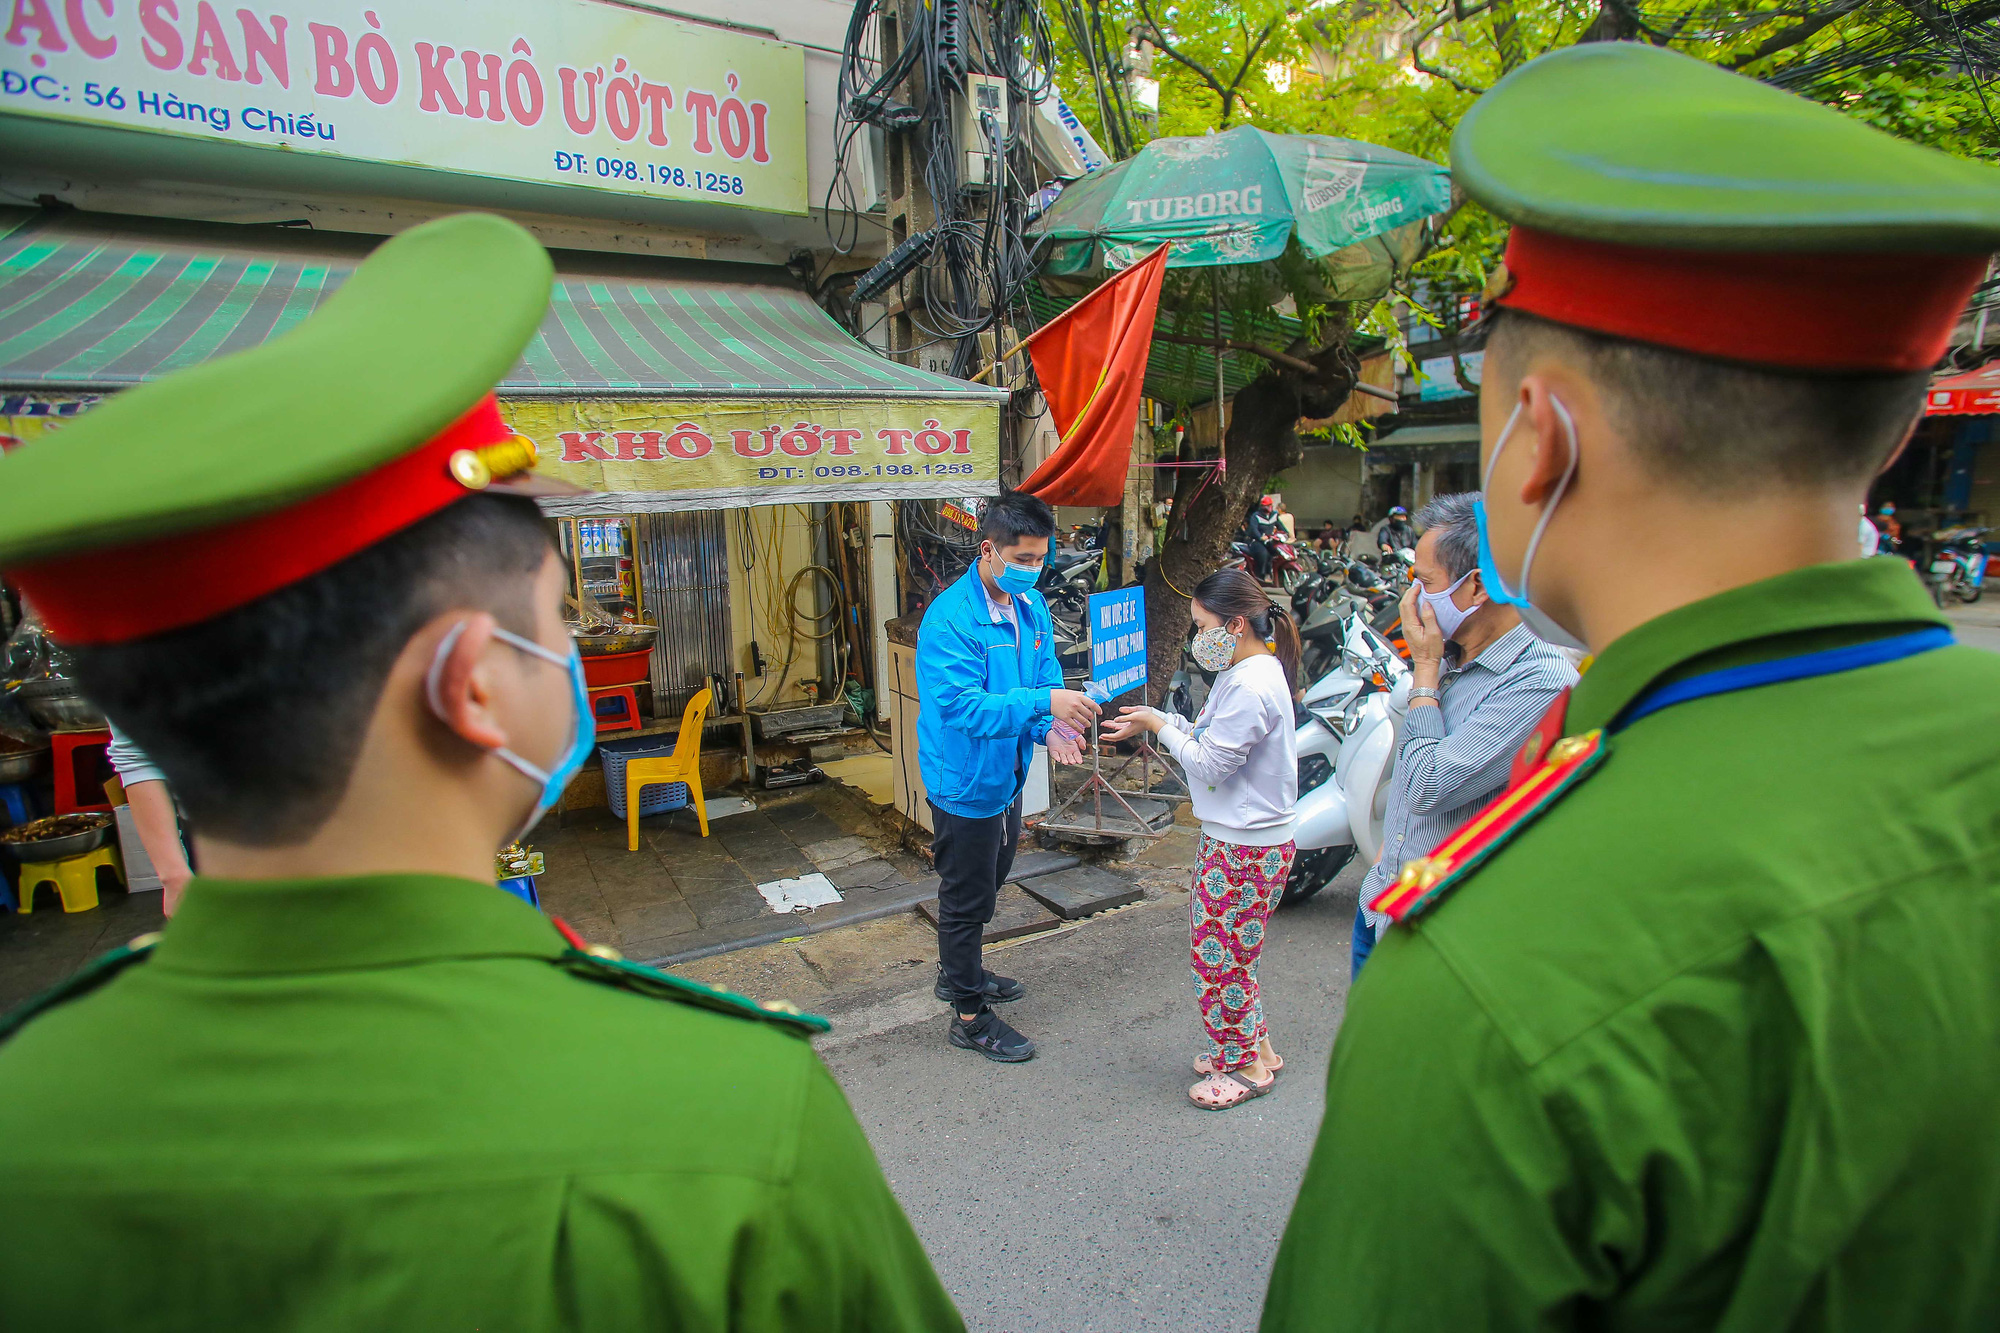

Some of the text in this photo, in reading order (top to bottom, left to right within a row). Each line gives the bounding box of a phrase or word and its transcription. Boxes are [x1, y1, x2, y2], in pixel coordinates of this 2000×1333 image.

[1, 70, 336, 141] ĐC: 56 Hàng Chiếu
[308, 10, 400, 105] BÒ
[414, 37, 544, 127] KHÔ
[558, 58, 673, 148] ƯỚT
[686, 73, 770, 163] TỎI
[554, 150, 744, 196] ĐT: 098.198.1258
[1127, 185, 1262, 223] TUBORG
[1348, 197, 1403, 227] TUBORG
[559, 418, 973, 463] KHÔ ƯỚT TỎI
[758, 462, 974, 480] ĐT: 098.198.1258
